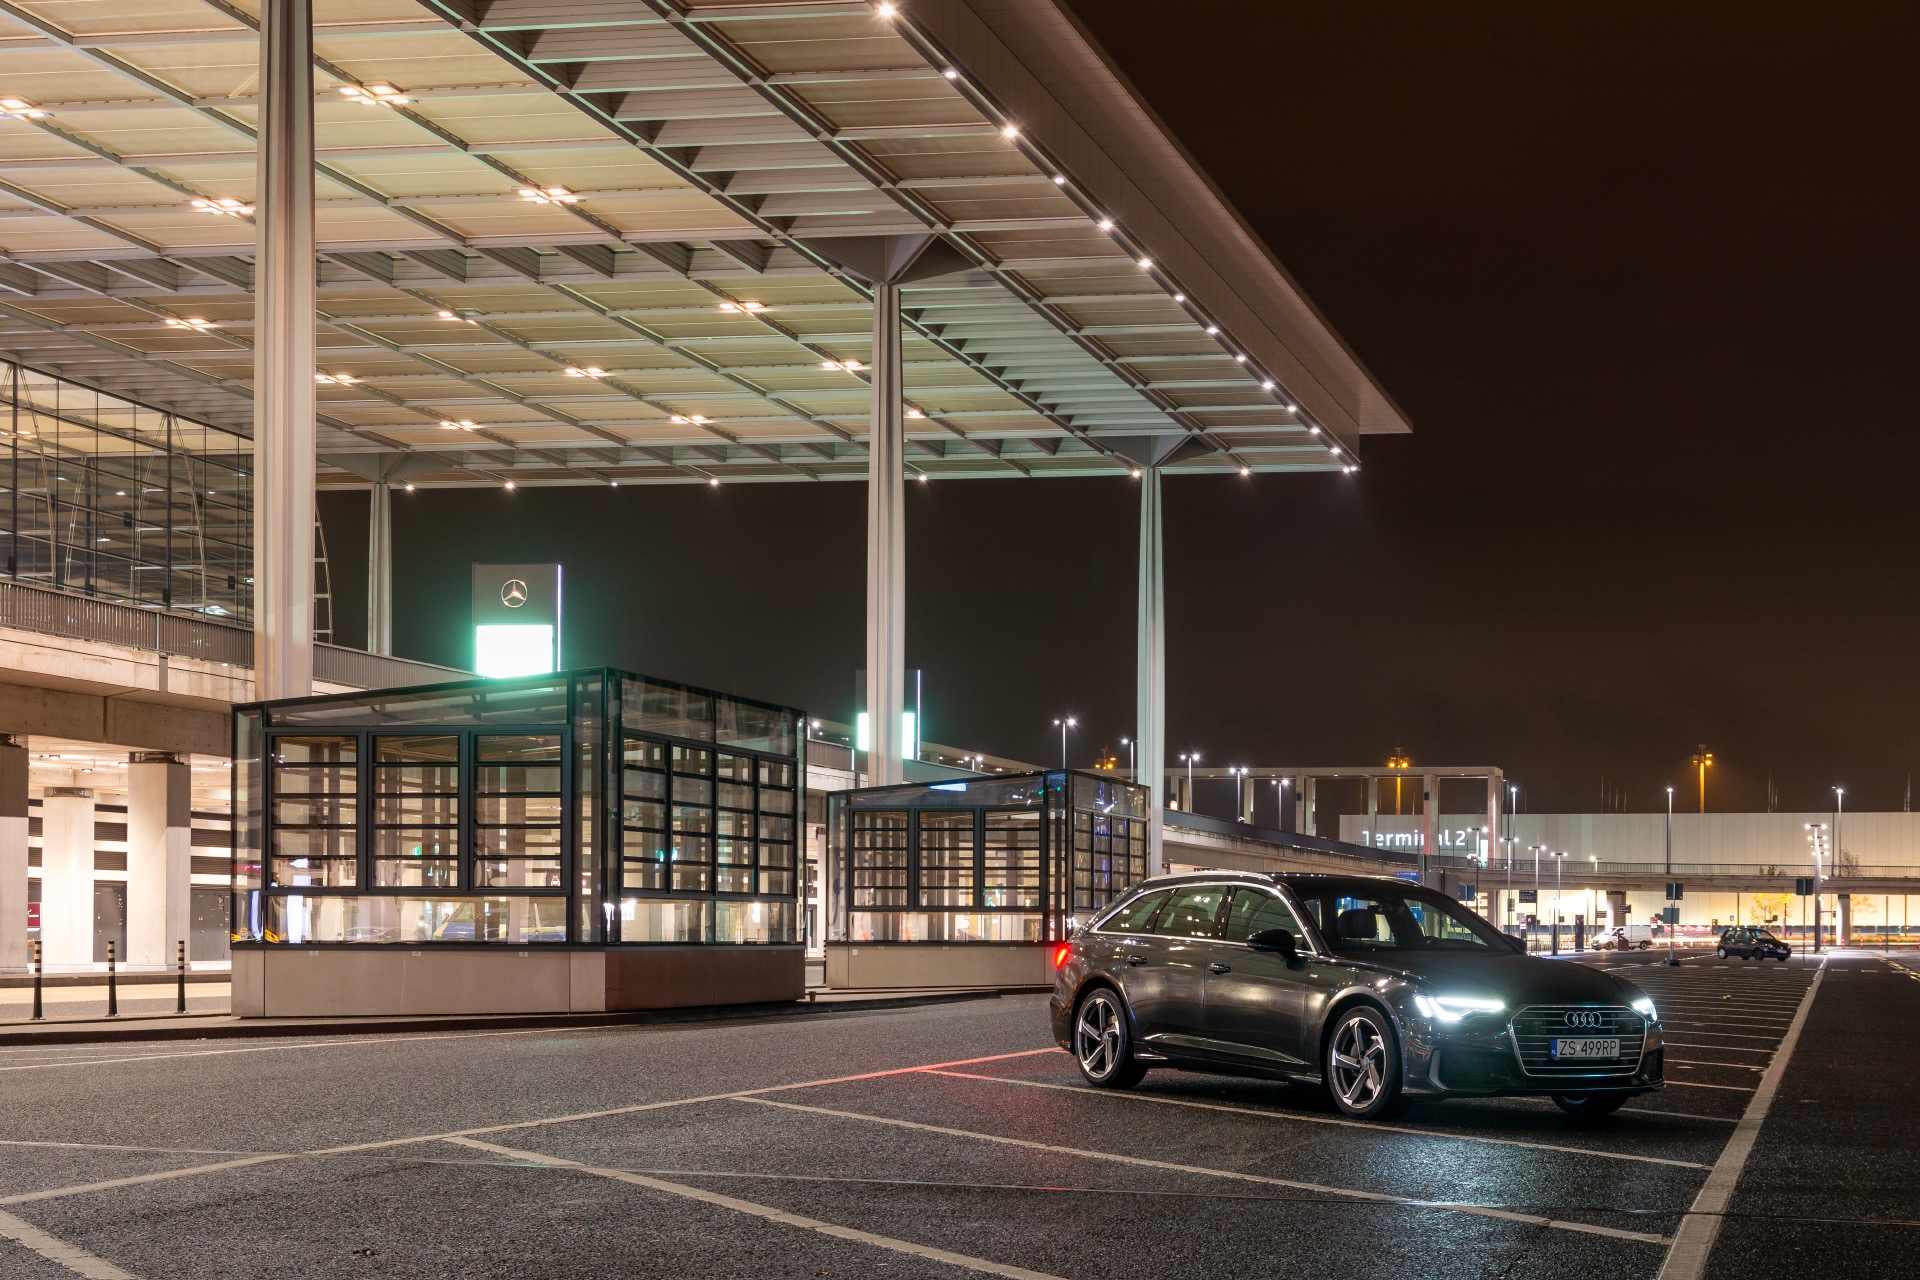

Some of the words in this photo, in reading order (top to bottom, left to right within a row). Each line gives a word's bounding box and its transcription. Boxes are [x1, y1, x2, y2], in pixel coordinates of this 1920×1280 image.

[1455, 830, 1466, 846] 2
[1559, 1041, 1576, 1055] ZS
[1581, 1041, 1617, 1055] 499RP
